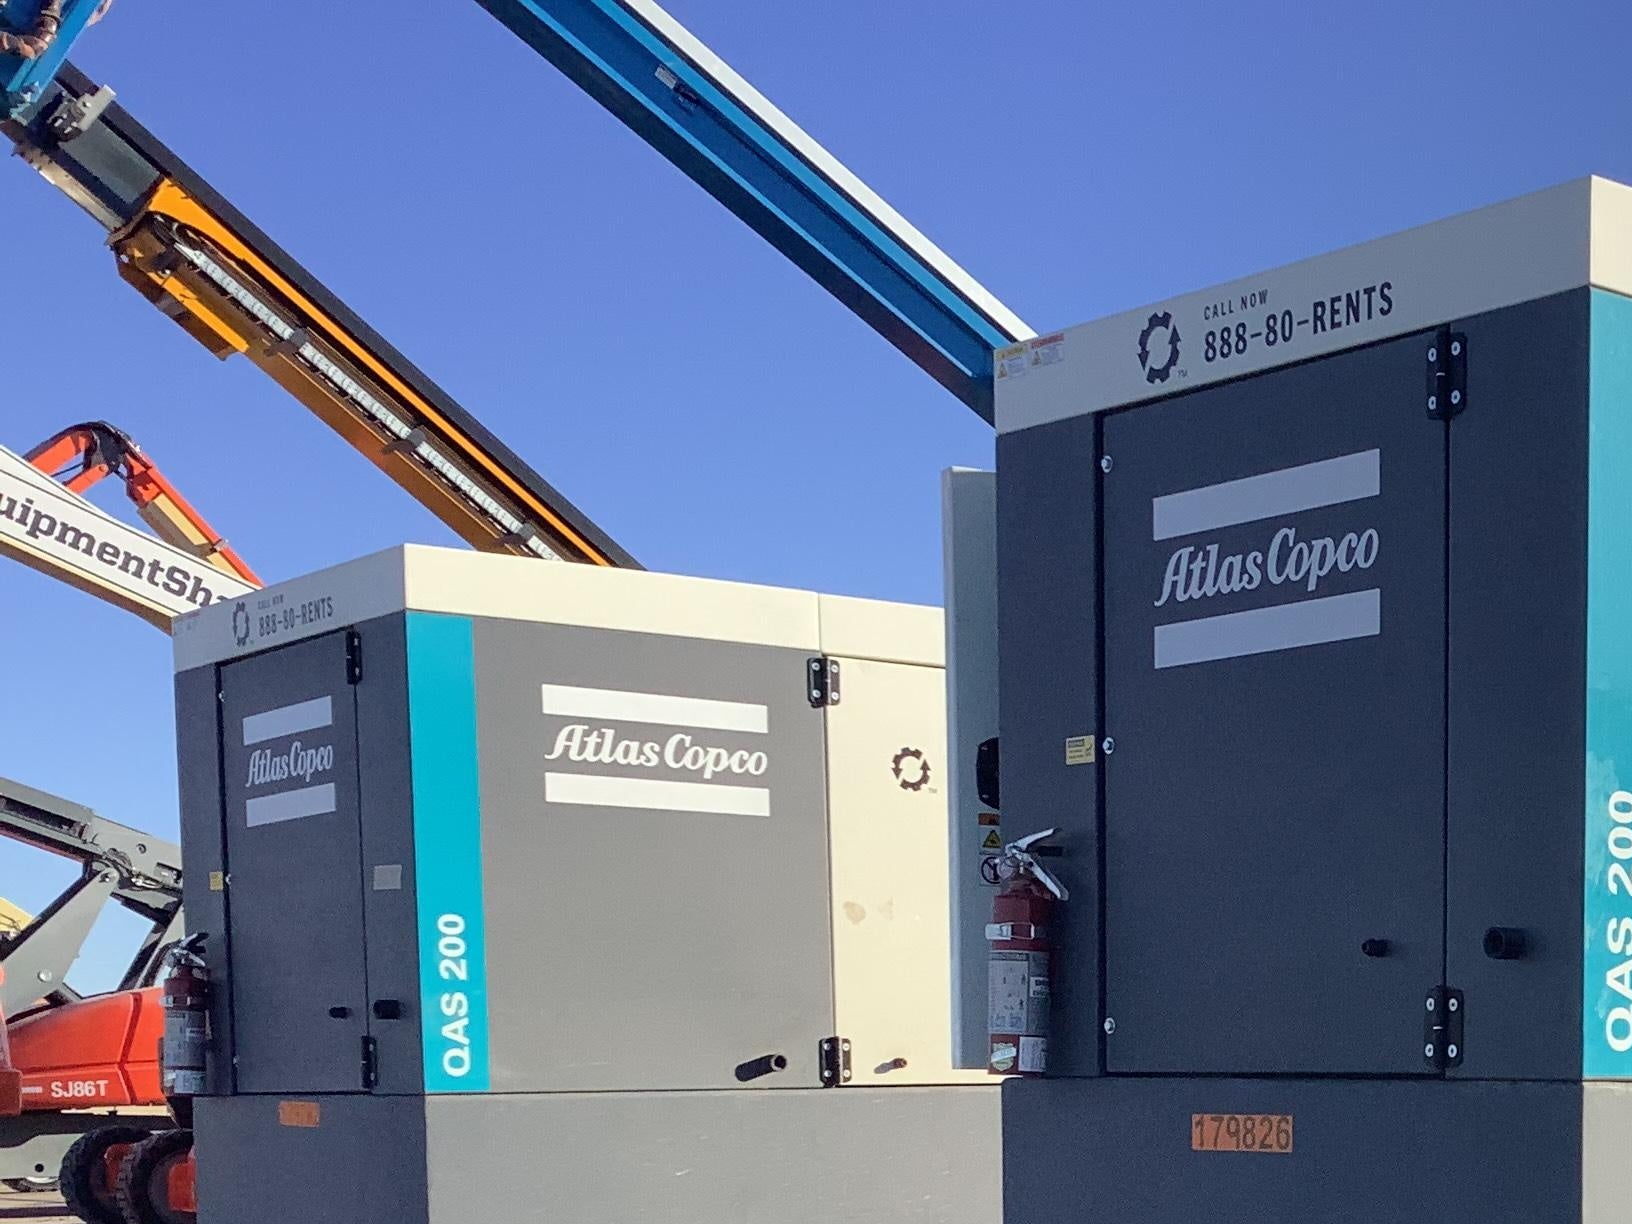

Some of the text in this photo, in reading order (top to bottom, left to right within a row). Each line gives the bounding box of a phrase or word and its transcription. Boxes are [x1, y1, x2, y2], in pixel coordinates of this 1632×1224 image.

[1204, 288, 1269, 320] CALL NOW
[1204, 281, 1393, 363] 888-80-RENTS
[0, 492, 229, 607] uipmentSh
[1153, 527, 1380, 607] Atlas Copco
[258, 596, 334, 638] 888-80-RENTS
[245, 741, 333, 787] Atlas Copco
[544, 724, 768, 779] Atlas Copco
[437, 913, 471, 1078] QAS 200
[51, 1080, 109, 1098] SJ86T
[1194, 1115, 1291, 1150] 179826
